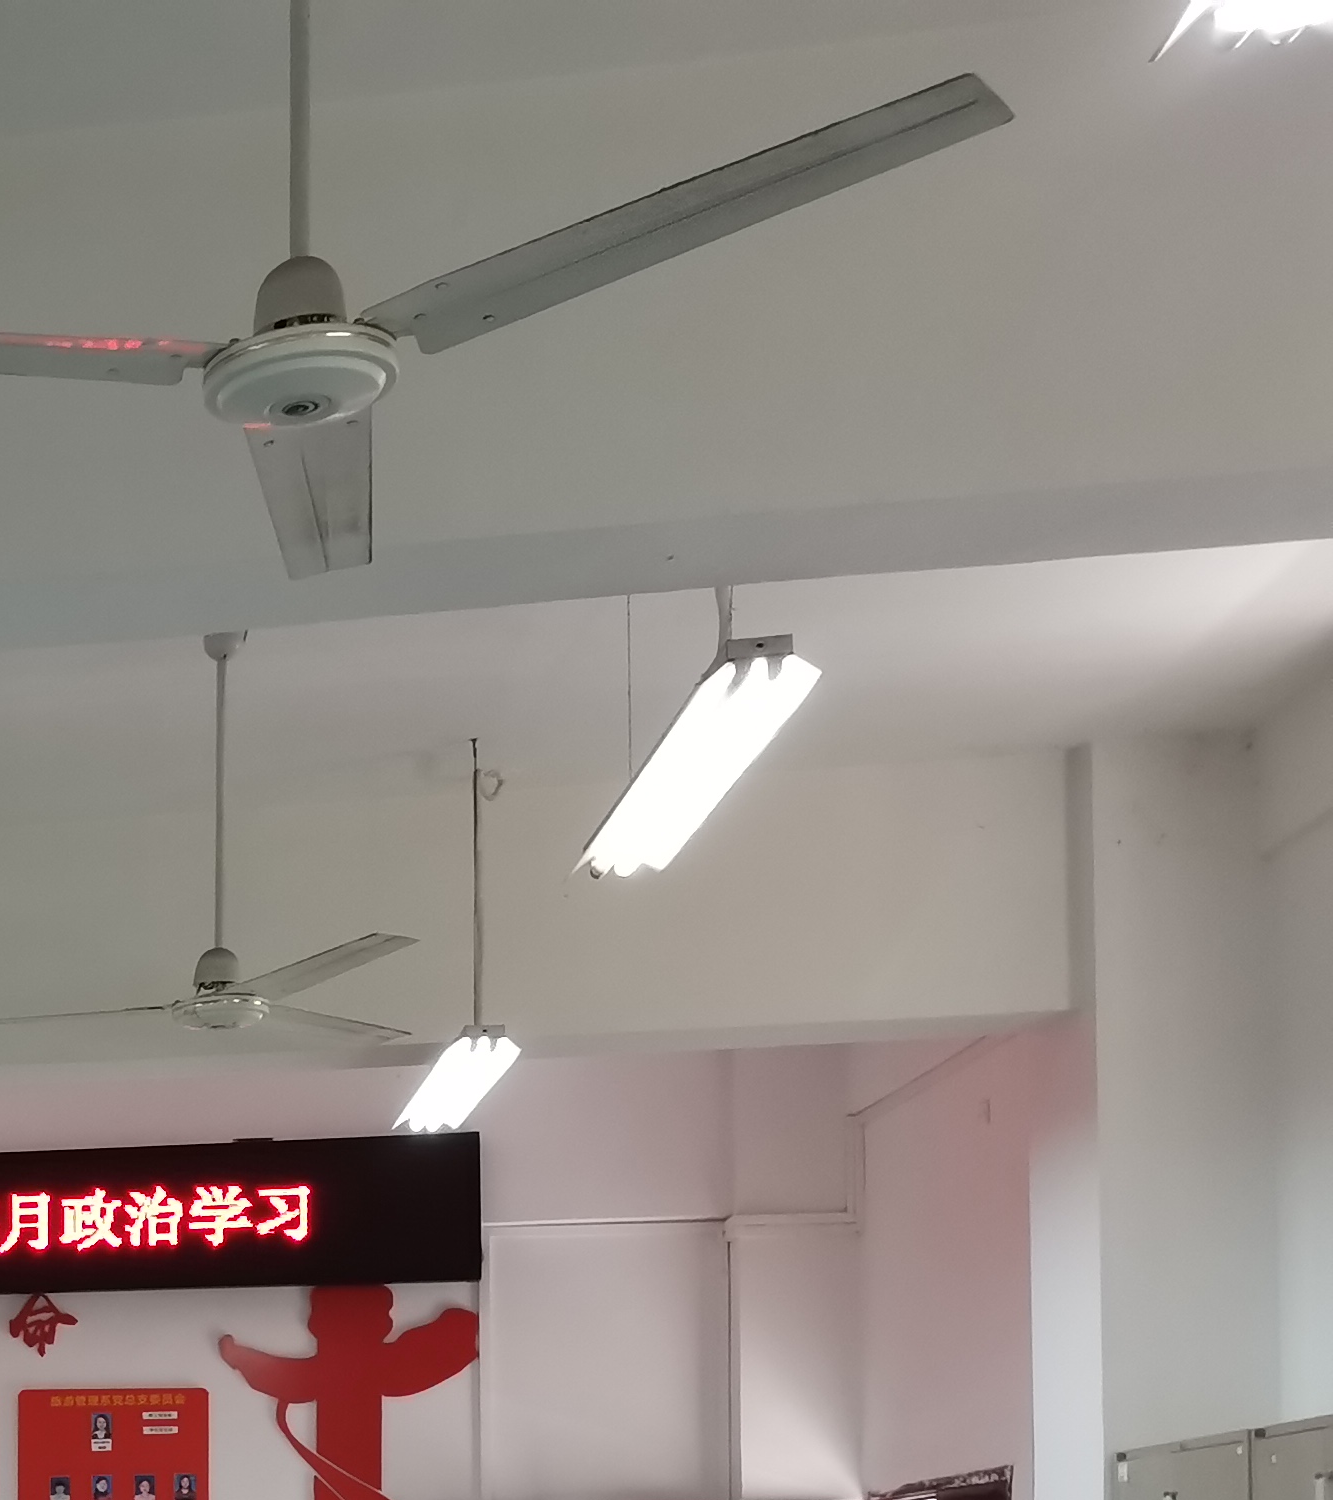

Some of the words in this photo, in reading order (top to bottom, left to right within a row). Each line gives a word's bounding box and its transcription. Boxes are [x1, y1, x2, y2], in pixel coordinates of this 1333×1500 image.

[50, 1393, 186, 1408] 旅游管理系党总支委员会
